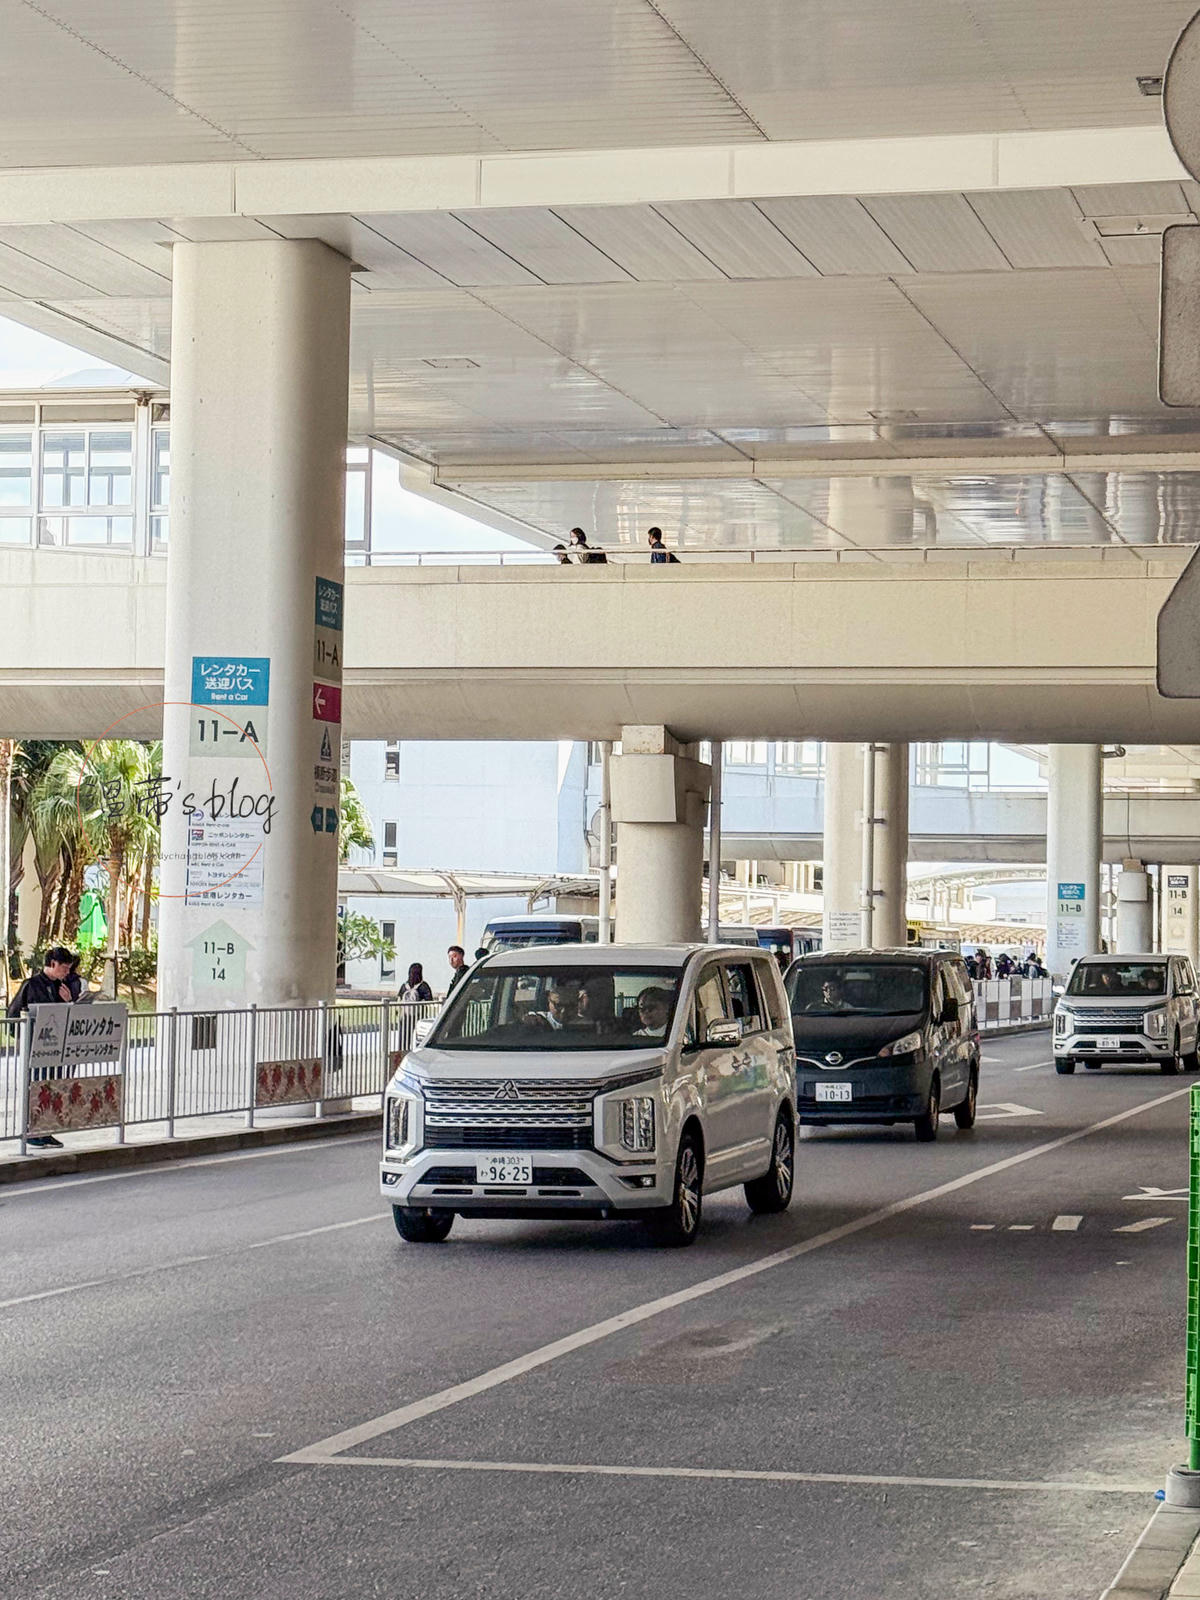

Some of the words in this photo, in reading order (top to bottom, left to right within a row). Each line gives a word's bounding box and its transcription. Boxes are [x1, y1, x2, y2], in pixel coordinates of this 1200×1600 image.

[317, 640, 339, 667] 11-A
[201, 664, 260, 676] レンタカー
[205, 677, 254, 690] 送迎バス
[198, 720, 259, 742] 11-A
[204, 941, 235, 954] 11-B
[212, 968, 226, 980] 14
[68, 1016, 121, 1037] ABCレンタカー
[489, 1166, 530, 1181] 96-25
